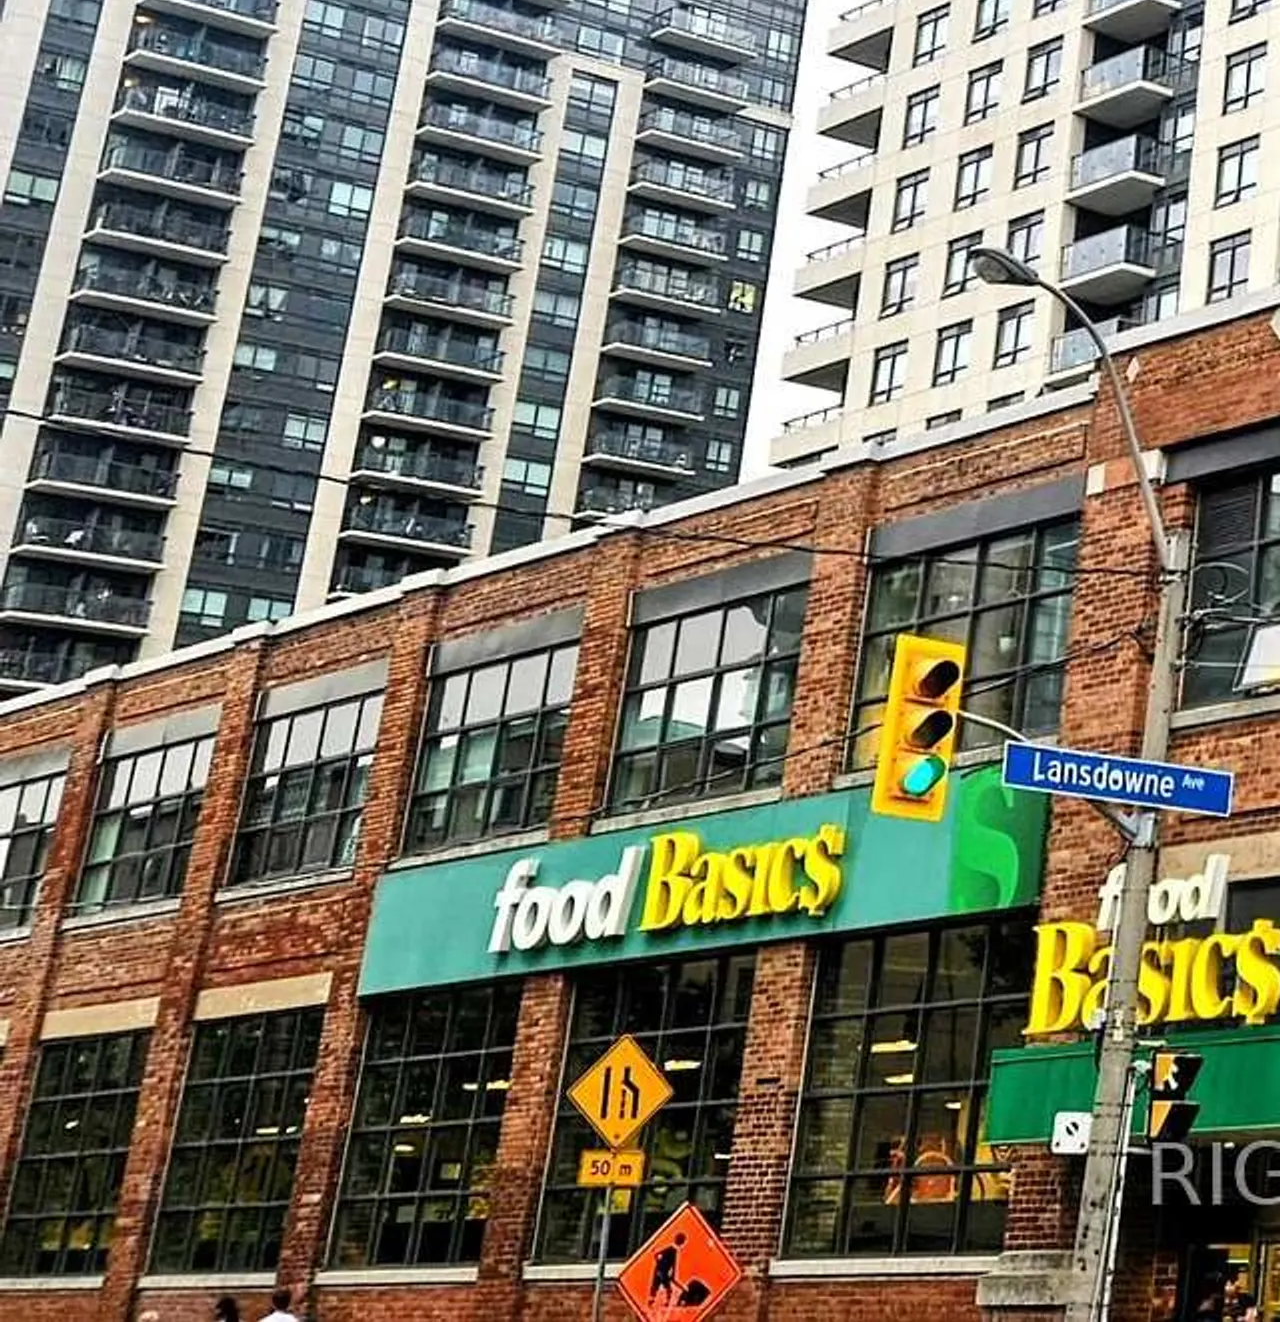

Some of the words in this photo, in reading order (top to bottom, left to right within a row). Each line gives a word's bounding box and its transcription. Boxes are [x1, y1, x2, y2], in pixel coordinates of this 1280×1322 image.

[1033, 751, 1175, 798] Lansdowne
[1182, 773, 1206, 791] Ave
[487, 845, 647, 954] food
[1096, 853, 1231, 930] fod
[590, 1160, 611, 1176] 50
[619, 1164, 632, 1177] m
